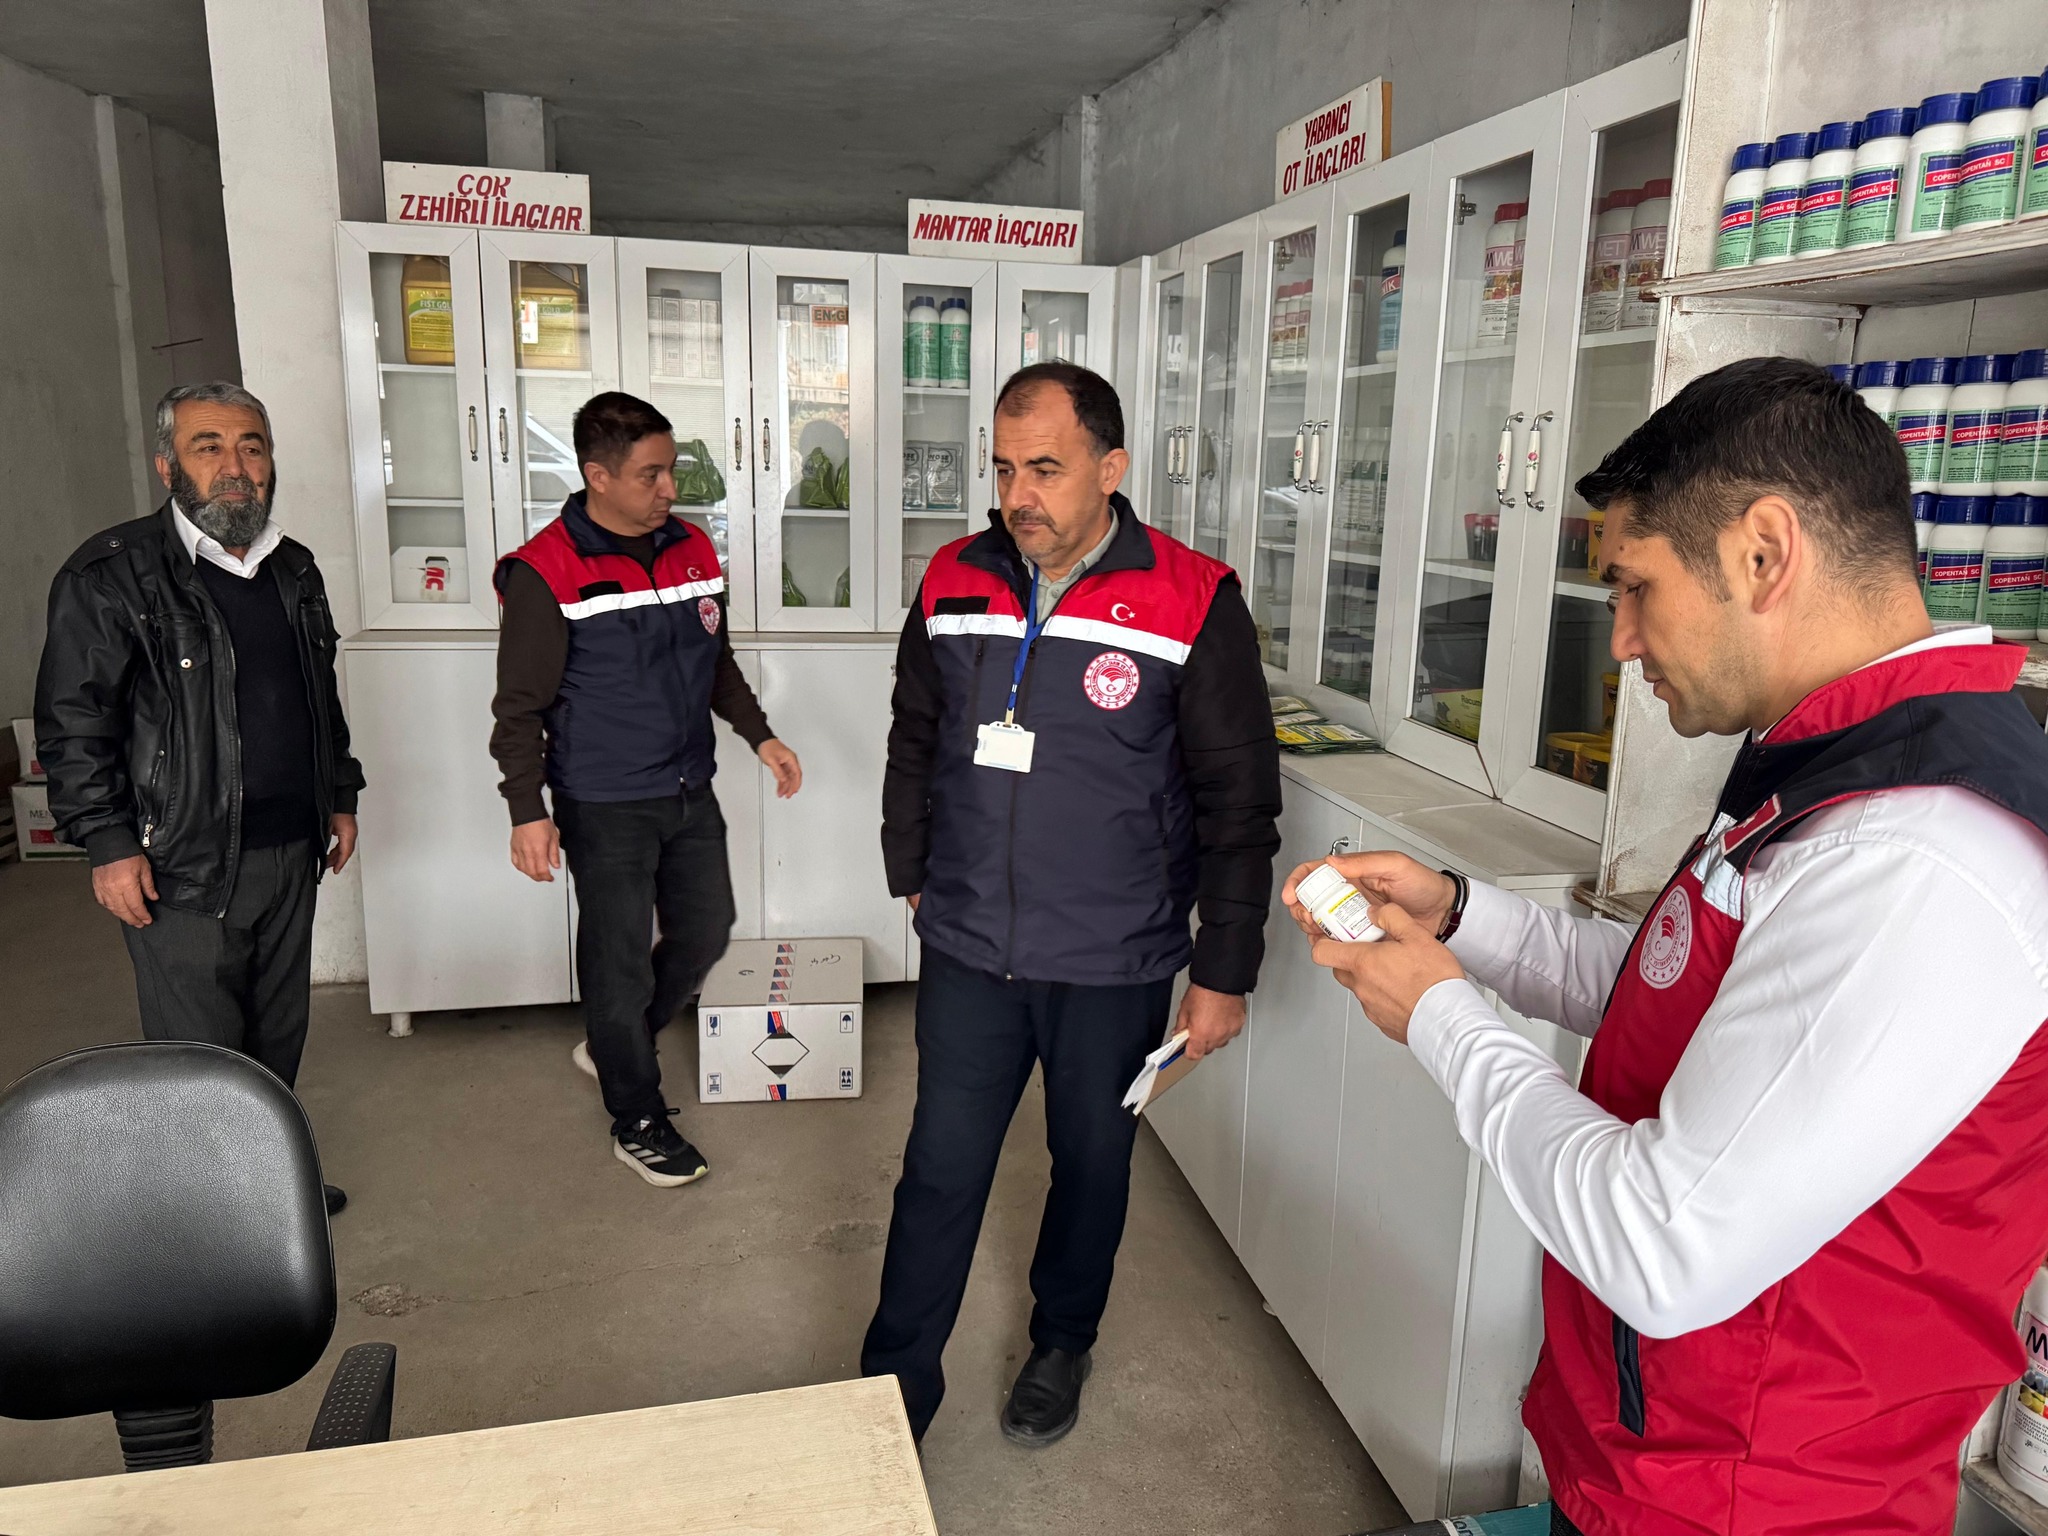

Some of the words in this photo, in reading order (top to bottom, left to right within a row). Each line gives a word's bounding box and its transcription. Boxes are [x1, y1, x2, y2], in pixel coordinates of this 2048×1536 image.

[1304, 100, 1352, 151] YABANCI
[1283, 160, 1302, 195] OT
[1303, 132, 1367, 187] İLAÇLARI
[1994, 158, 2006, 166] SC
[457, 173, 511, 198] ÇOK
[399, 191, 490, 226] ZEHİRLİ
[913, 213, 993, 244] MANTAR
[994, 213, 1078, 248] İLAÇLARI
